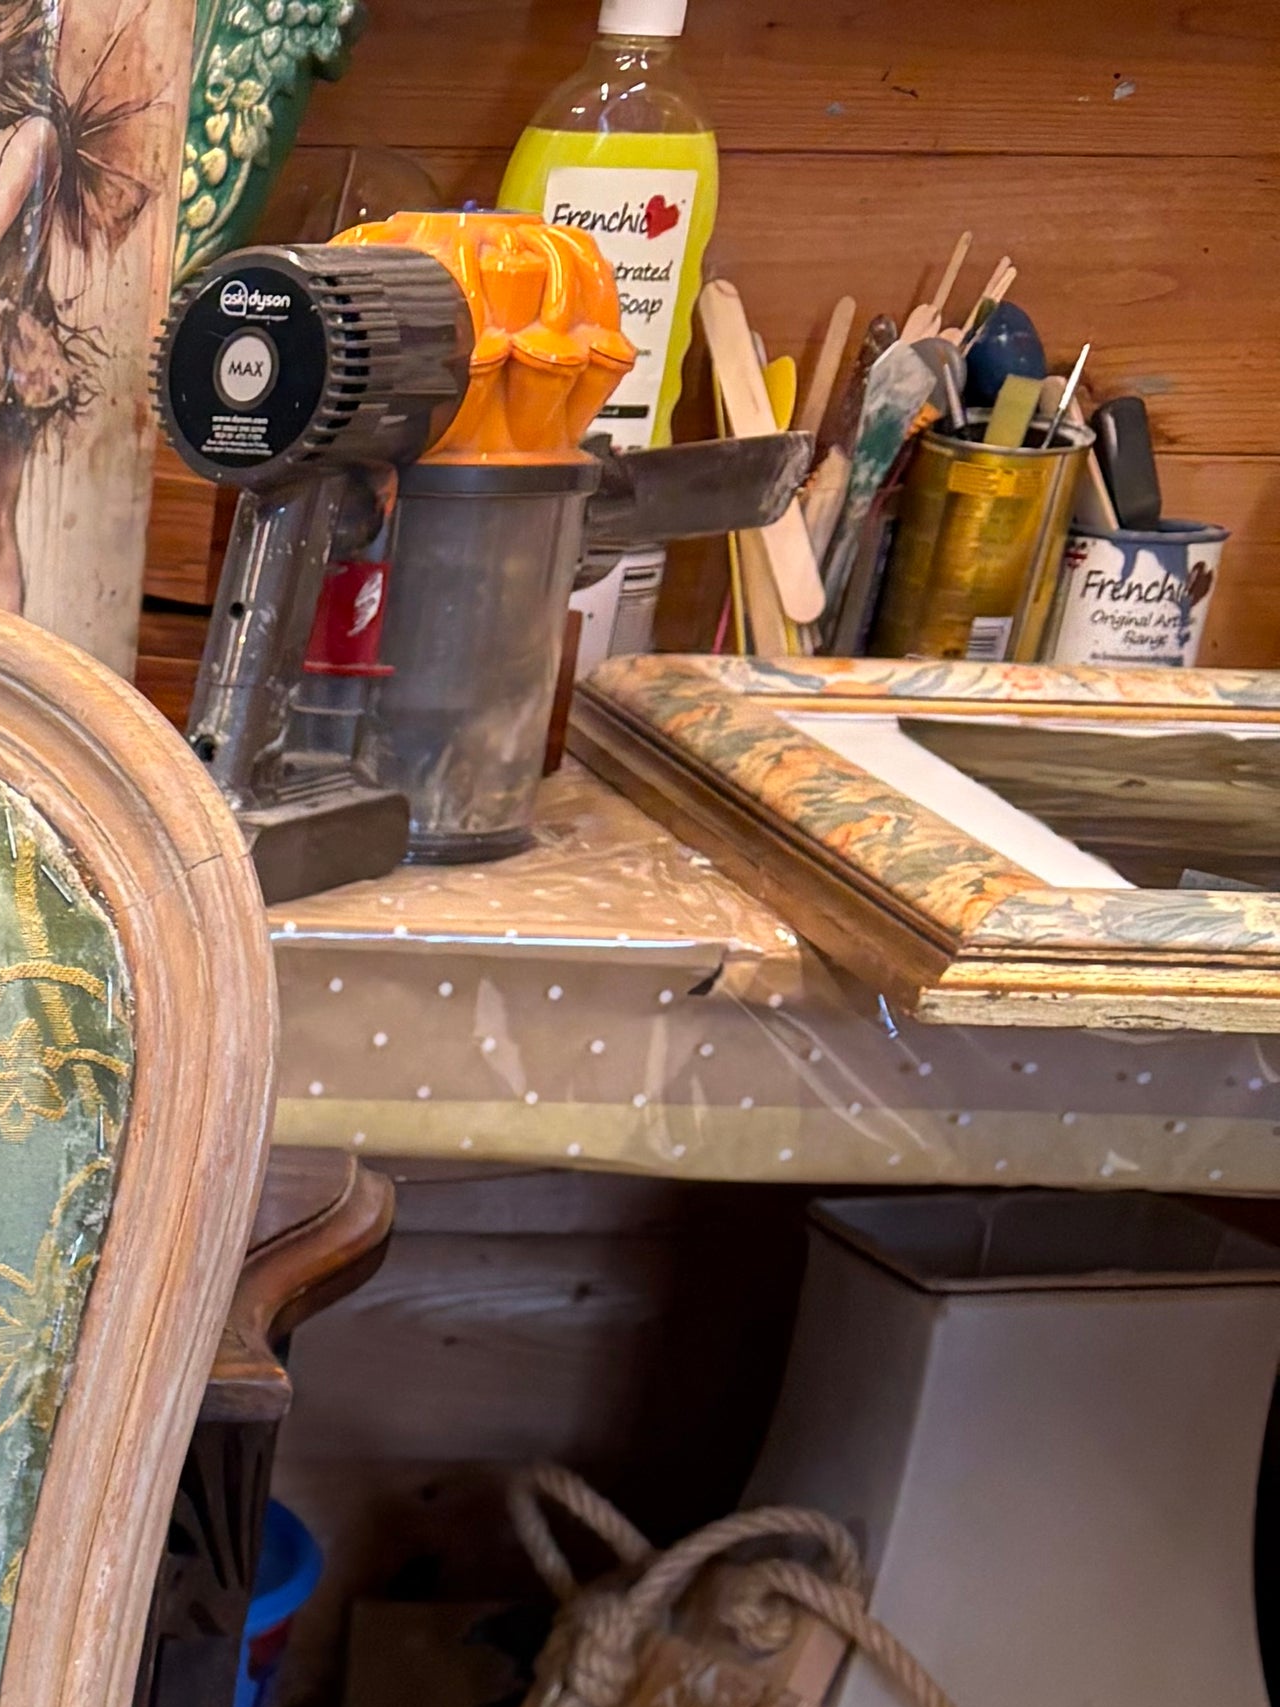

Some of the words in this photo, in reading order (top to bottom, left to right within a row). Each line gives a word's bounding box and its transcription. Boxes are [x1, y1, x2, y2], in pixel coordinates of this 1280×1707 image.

[614, 260, 673, 281] trated
[248, 289, 290, 310] dyson
[228, 361, 263, 376] MAX
[1091, 609, 1153, 630] Original
[1123, 630, 1169, 649] Range
